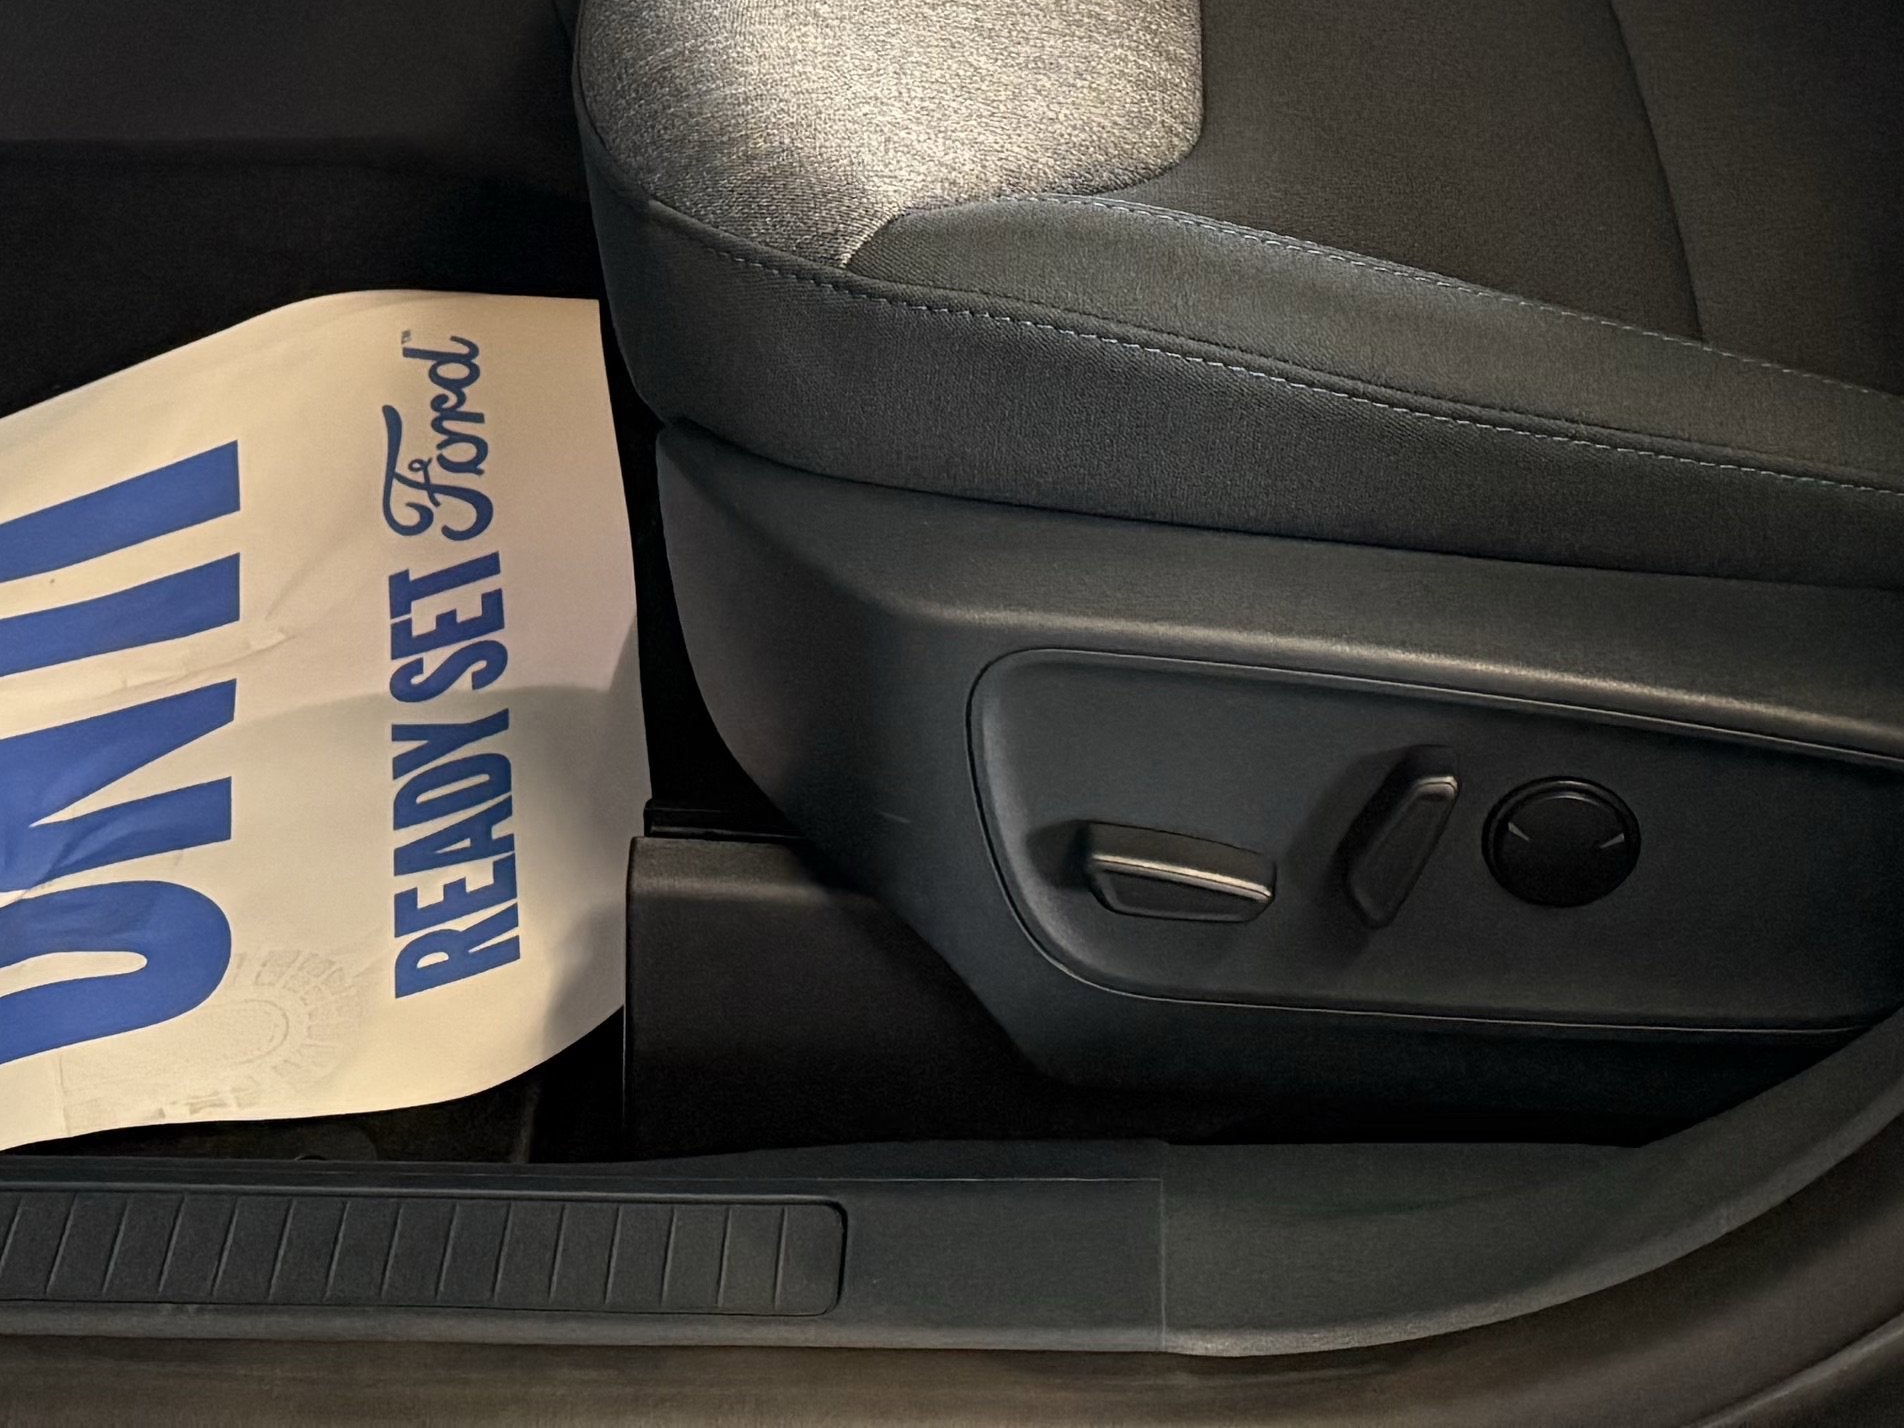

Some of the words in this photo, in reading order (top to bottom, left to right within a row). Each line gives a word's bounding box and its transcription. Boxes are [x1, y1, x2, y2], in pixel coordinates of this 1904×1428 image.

[381, 333, 495, 544] Ford
[387, 549, 509, 705] SET
[390, 706, 522, 1000] READY
